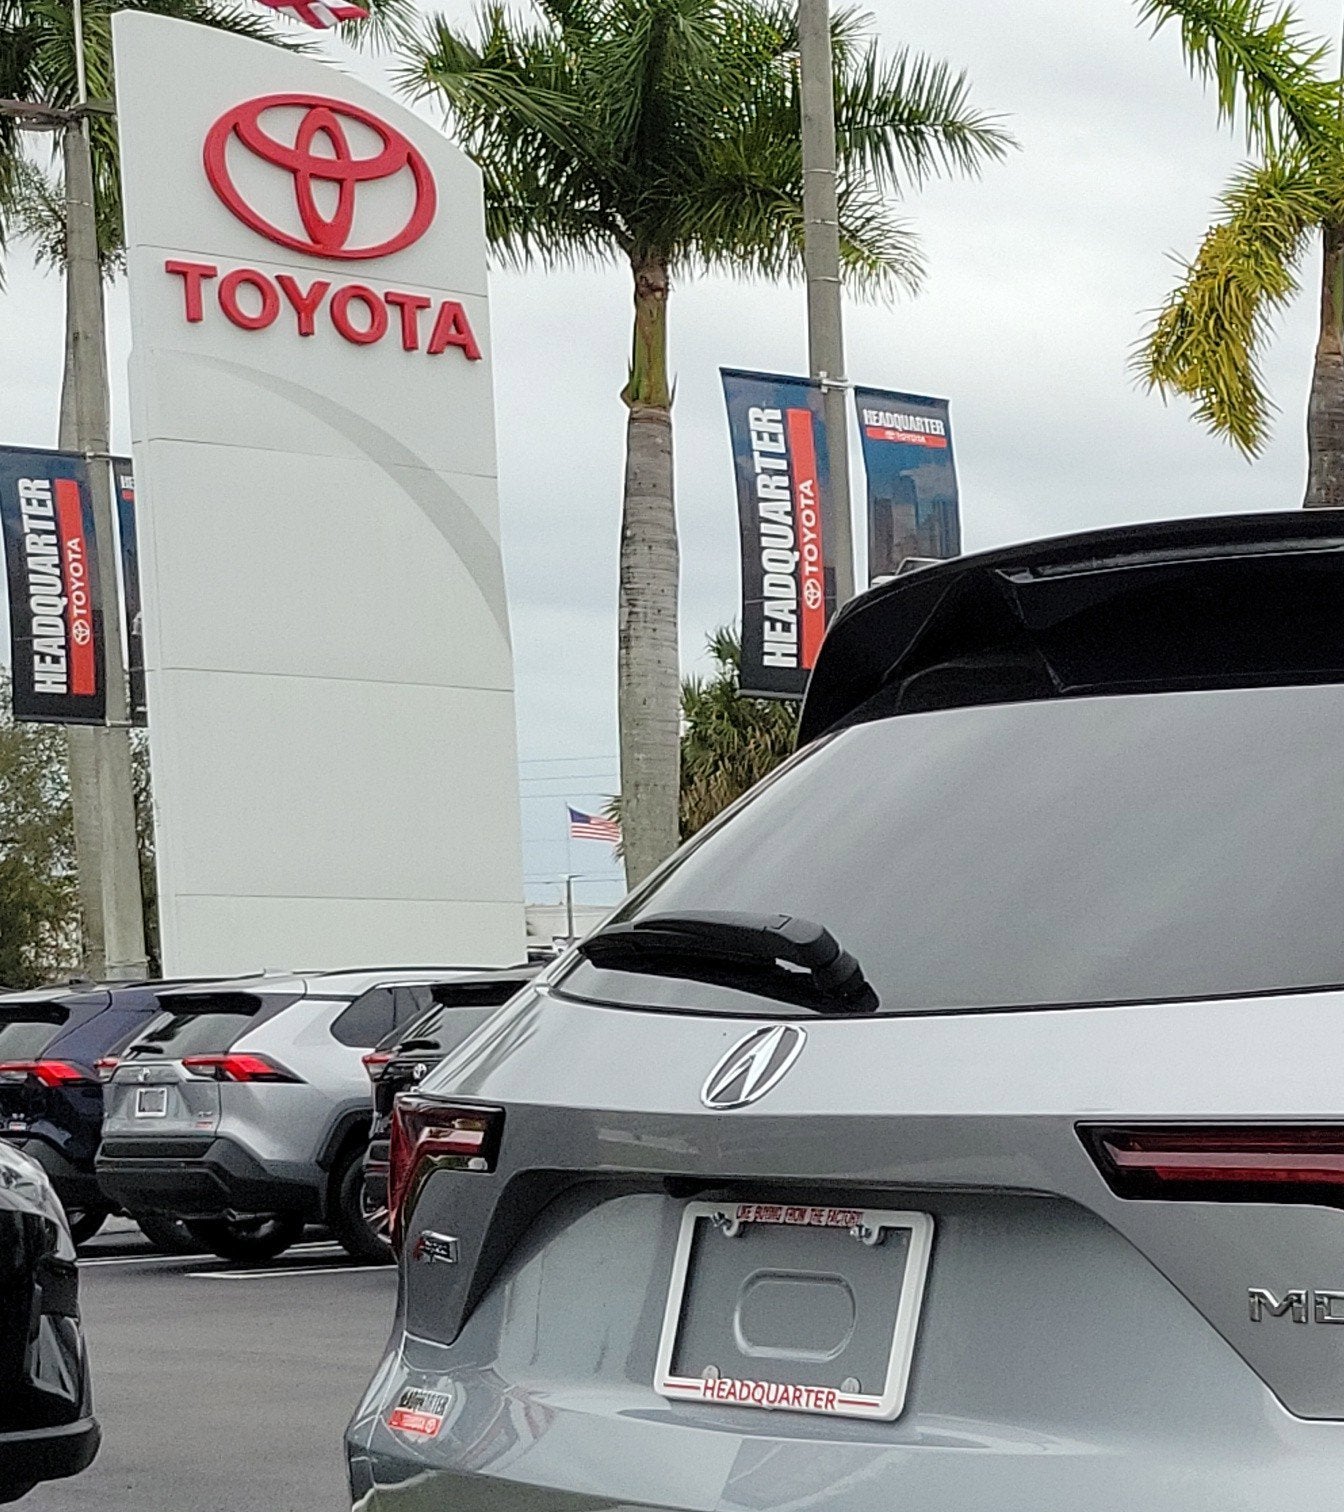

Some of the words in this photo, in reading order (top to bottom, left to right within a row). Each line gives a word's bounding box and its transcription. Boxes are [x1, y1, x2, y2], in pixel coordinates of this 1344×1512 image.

[165, 260, 483, 361] TOYOTA
[863, 408, 946, 436] HEADQUARTER
[748, 406, 801, 669] HEADQUARTER
[799, 479, 819, 575] TOYOTA
[18, 477, 68, 695] HEADQUARTER
[67, 538, 85, 617] TOYOTA
[703, 1379, 837, 1410] HEADQUARTER
